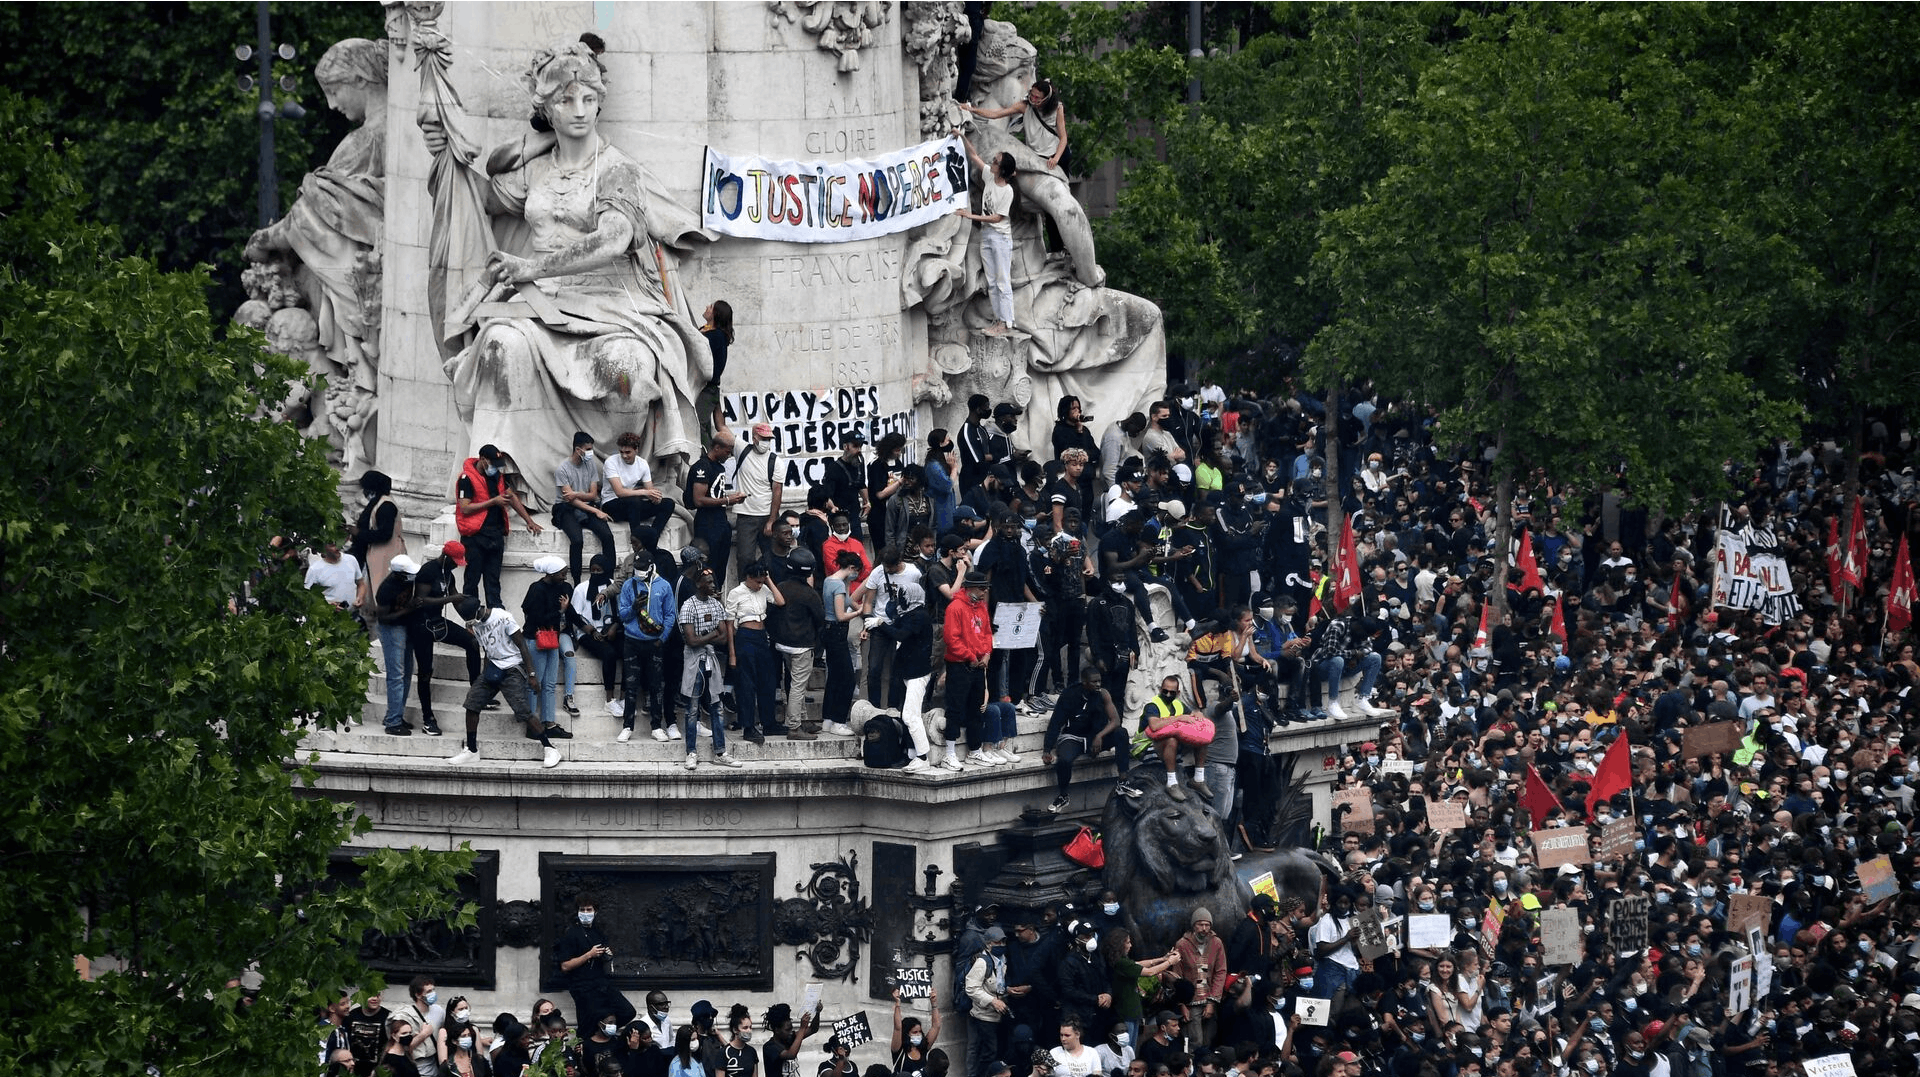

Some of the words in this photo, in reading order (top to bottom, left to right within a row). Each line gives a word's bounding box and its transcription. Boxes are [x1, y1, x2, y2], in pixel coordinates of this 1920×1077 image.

[843, 96, 862, 114] LA
[805, 128, 876, 155] GLOIRE
[707, 162, 744, 221] NO
[747, 166, 853, 228] JUSTICE
[840, 296, 860, 315] LA
[774, 328, 832, 352] VILLE
[839, 326, 861, 350] DE
[723, 396, 757, 422] AU
[765, 389, 834, 421] PAYS
[838, 386, 878, 419] DES
[440, 805, 485, 824] 1870
[575, 808, 592, 826] 14
[599, 807, 688, 827] JUILLET
[696, 807, 743, 826] 1880
[897, 968, 931, 982] JUSTICE
[899, 984, 933, 998] ADAMA
[833, 1019, 847, 1031] PAS
[848, 1015, 858, 1025] DE
[838, 1035, 852, 1045] PAS
[854, 1031, 863, 1040] DE
[848, 1036, 871, 1049] PAIX
[1808, 1062, 1850, 1076] VICTOIRE
